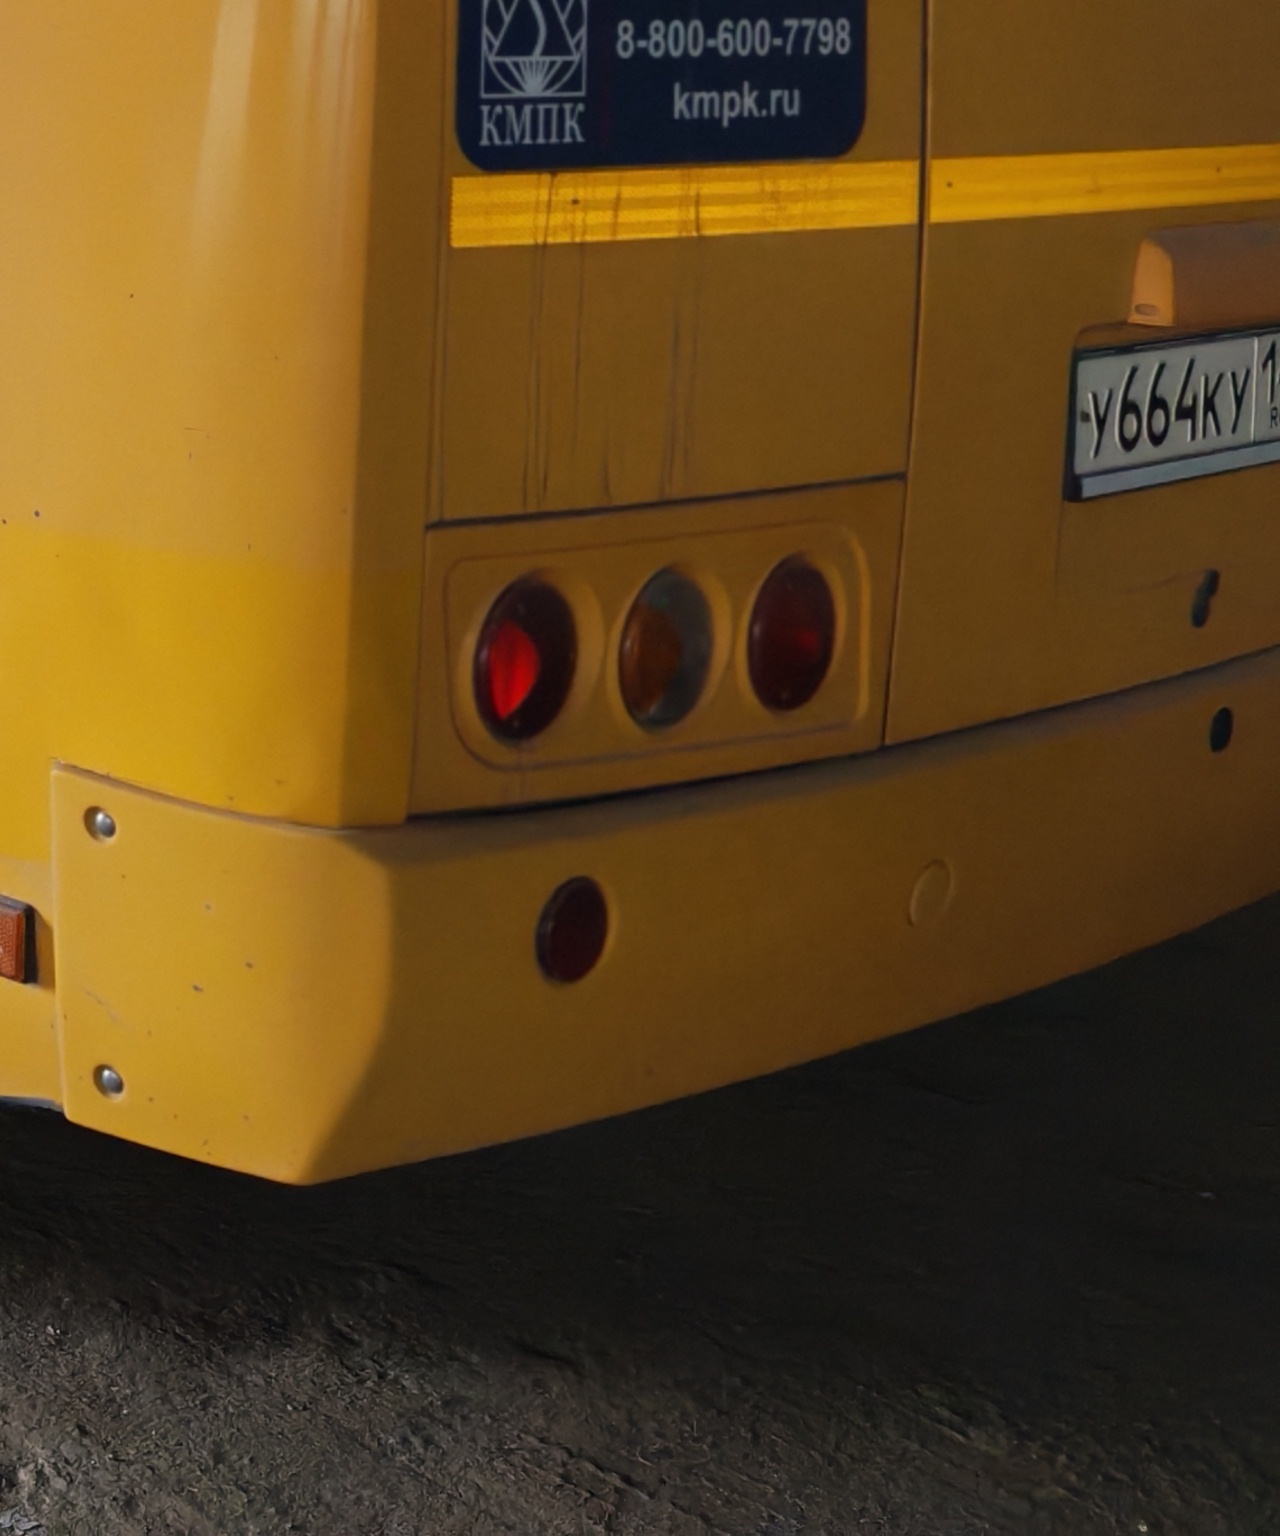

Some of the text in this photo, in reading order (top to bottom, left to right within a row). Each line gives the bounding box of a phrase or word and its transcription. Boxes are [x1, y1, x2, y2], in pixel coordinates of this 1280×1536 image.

[616, 18, 851, 59] 8-800-600-7798
[479, 102, 586, 147] КМПК
[673, 82, 801, 128] kmpk.ru
[1088, 356, 1252, 460] У664КУ
